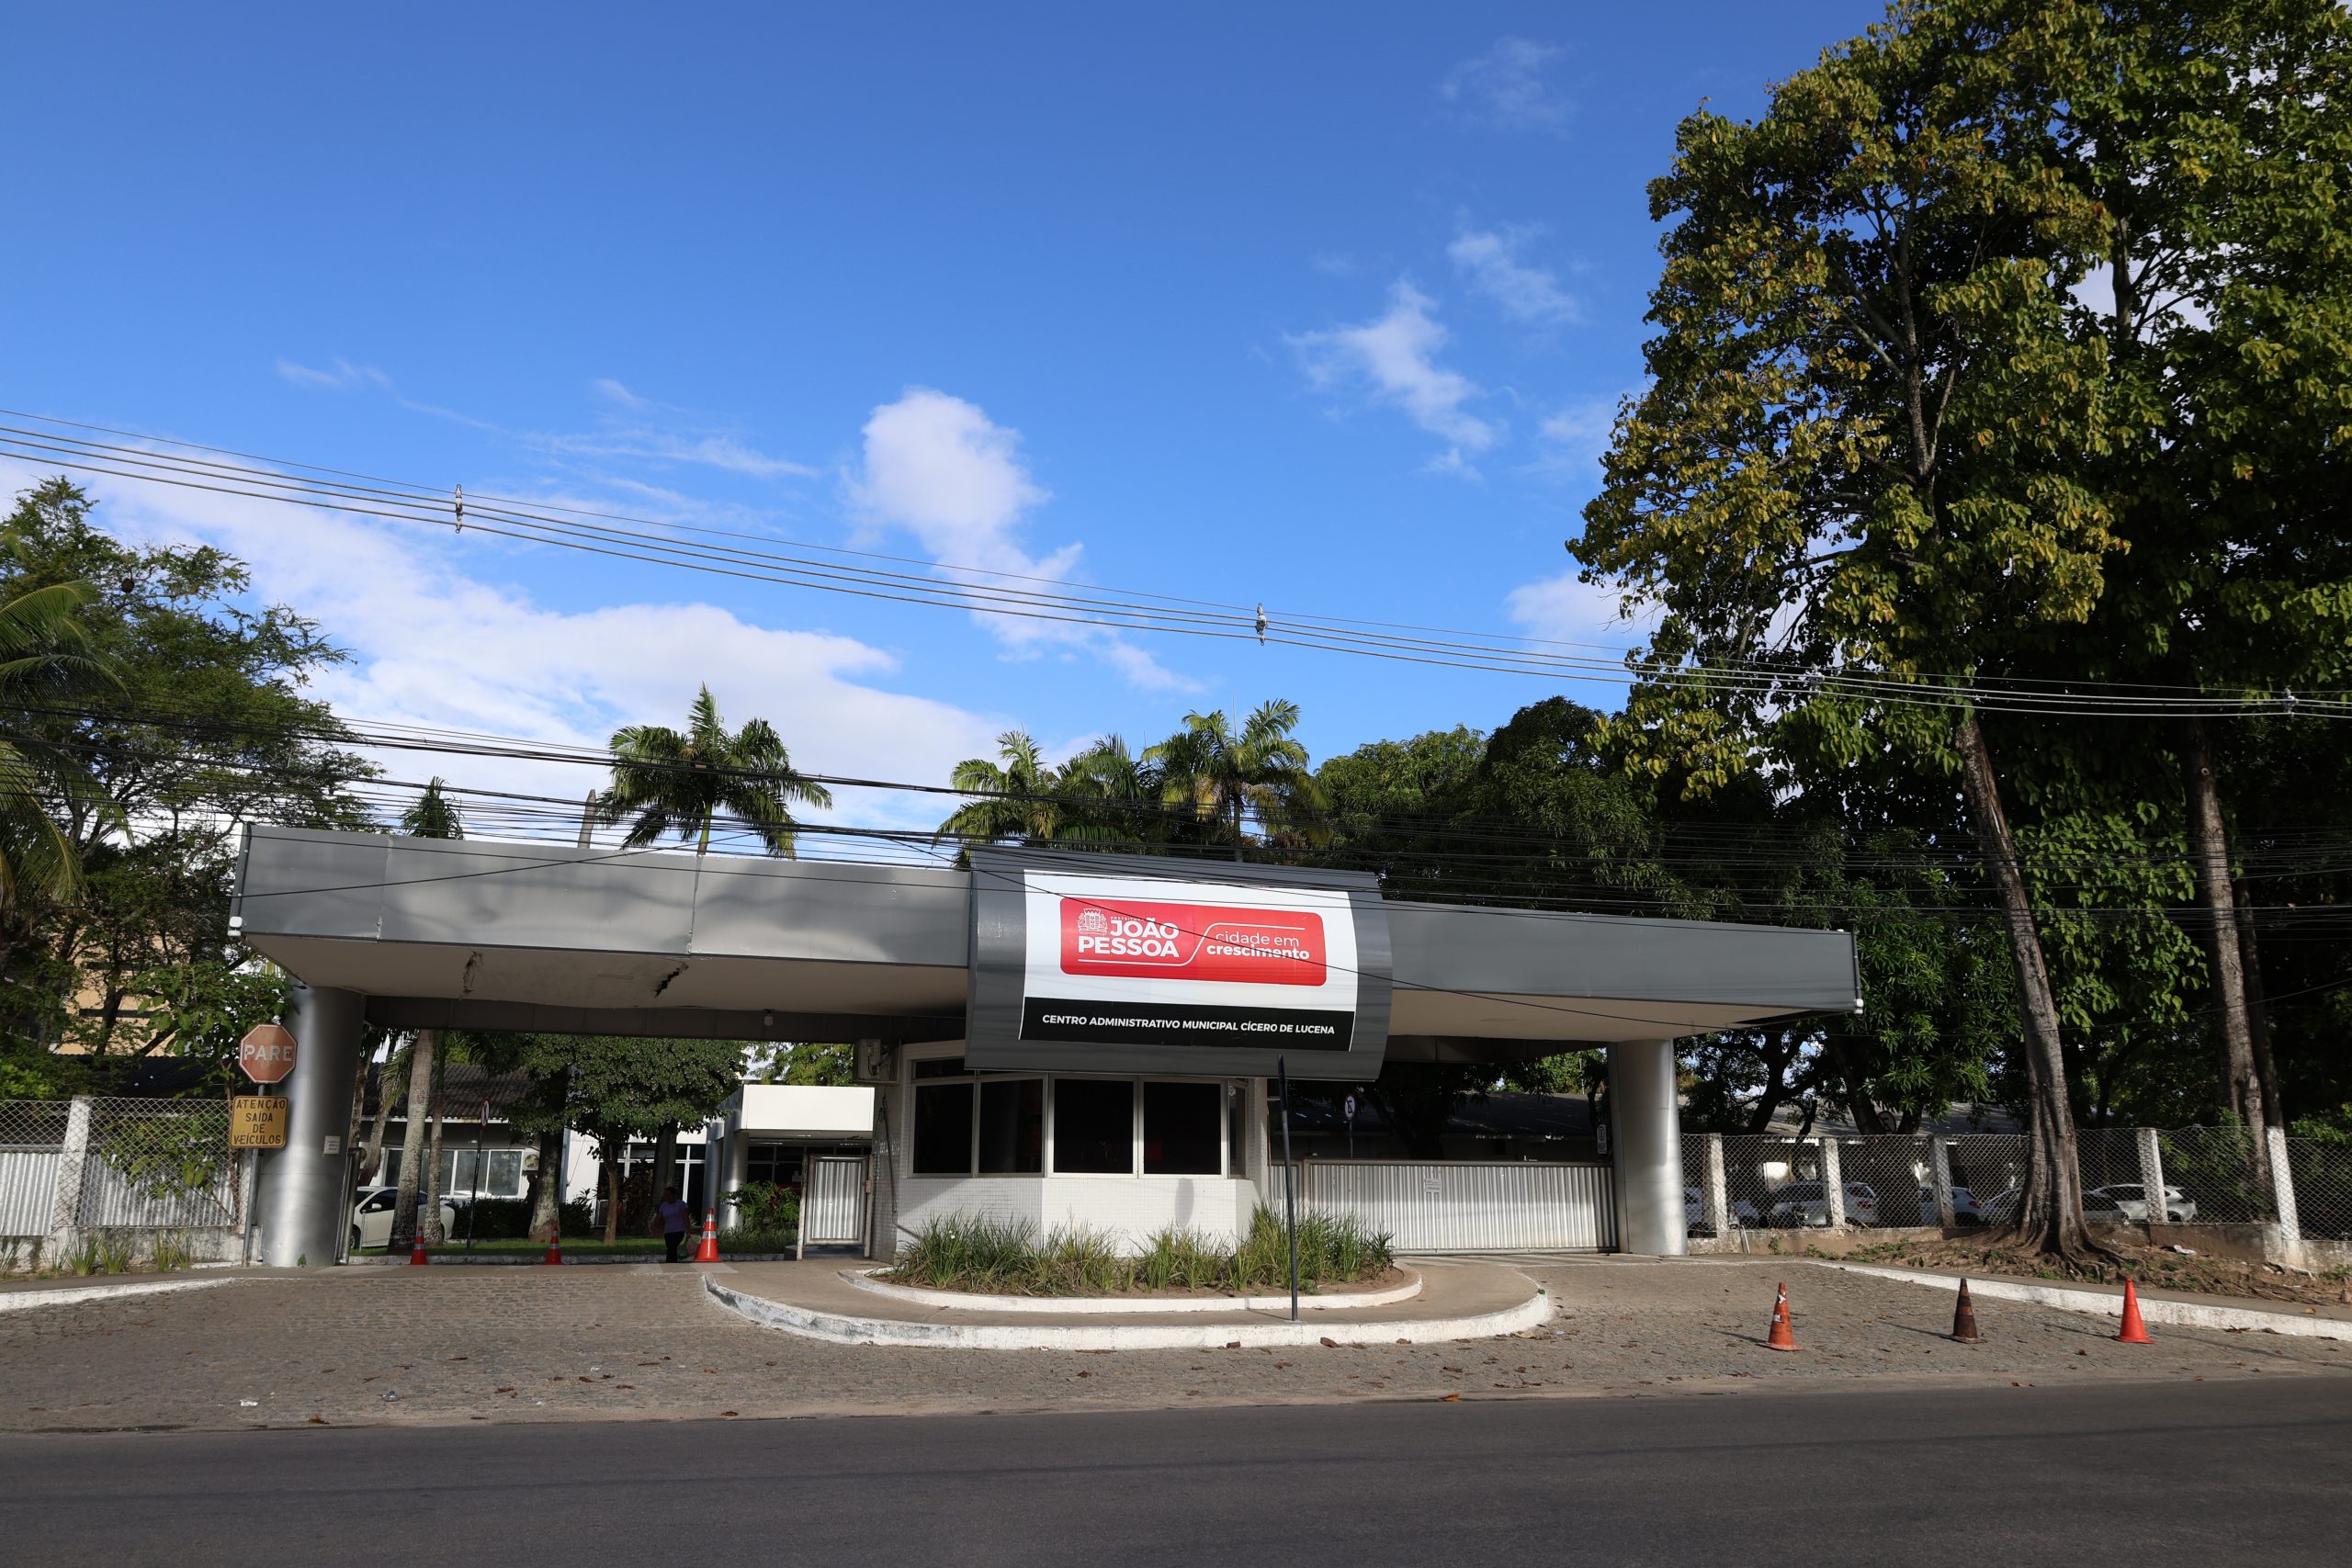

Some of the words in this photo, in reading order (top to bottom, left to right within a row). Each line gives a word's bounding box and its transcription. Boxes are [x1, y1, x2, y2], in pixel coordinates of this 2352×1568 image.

[1110, 917, 1180, 940] JOÃO
[1078, 935, 1180, 957] PESSOA
[1216, 931, 1271, 944] cidade
[1274, 937, 1299, 947] em
[1206, 944, 1310, 960] crescimento
[1042, 1014, 1087, 1025] CENTRO
[1089, 1017, 1181, 1029] ADMINISTRATIVO
[1182, 1020, 1238, 1031] MUNICIPAL
[1240, 1020, 1278, 1032] CÍCERO
[1279, 1023, 1294, 1033] DE
[1295, 1023, 1335, 1034] LUCENA
[243, 1044, 293, 1061] PARE
[253, 1123, 266, 1134] DE
[232, 1134, 281, 1145] VEÍCULOS
